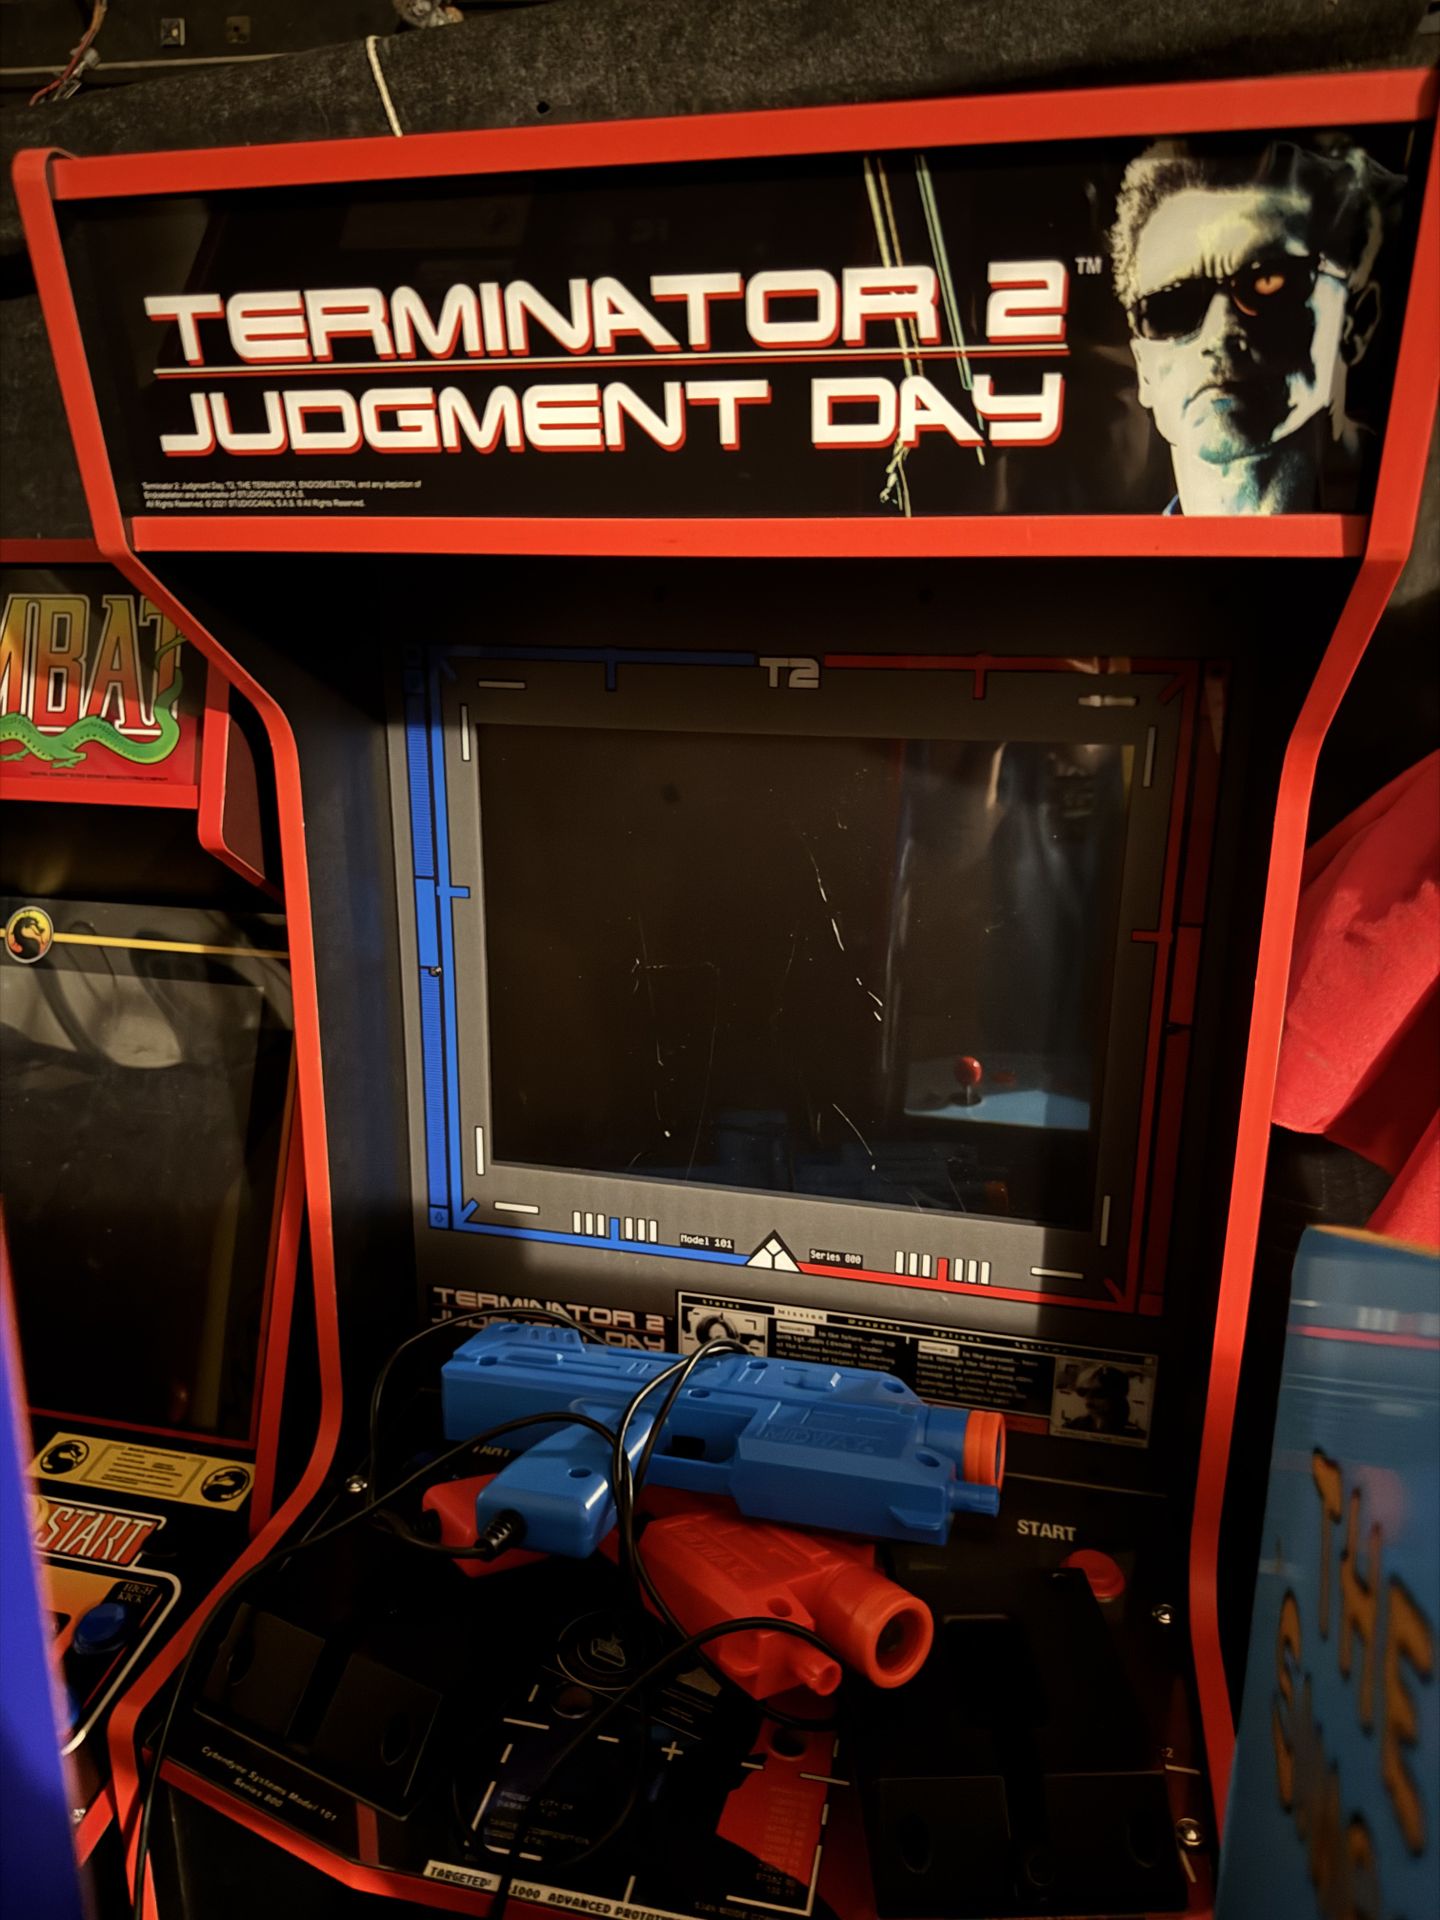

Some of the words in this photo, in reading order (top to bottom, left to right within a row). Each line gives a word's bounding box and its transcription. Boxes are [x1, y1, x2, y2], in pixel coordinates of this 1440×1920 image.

[1074, 256, 1102, 275] TM
[143, 264, 941, 367] TERMINATOR
[985, 259, 1069, 344] 2
[160, 379, 772, 457] JUDGMENT
[811, 373, 1065, 449] DAY
[760, 657, 819, 688] T2
[681, 1235, 709, 1247] Model
[714, 1239, 733, 1250] 101
[810, 1250, 841, 1262] Series
[433, 1287, 636, 1329] TERMINATOR
[645, 1314, 665, 1333] 2
[35, 1505, 156, 1563] START
[1016, 1519, 1077, 1542] START
[201, 1745, 248, 1775] Cyberdyne
[248, 1770, 287, 1797] Systems
[319, 1808, 337, 1822] 101
[233, 1777, 263, 1798] Series
[549, 1891, 611, 1914] ADVANCED
